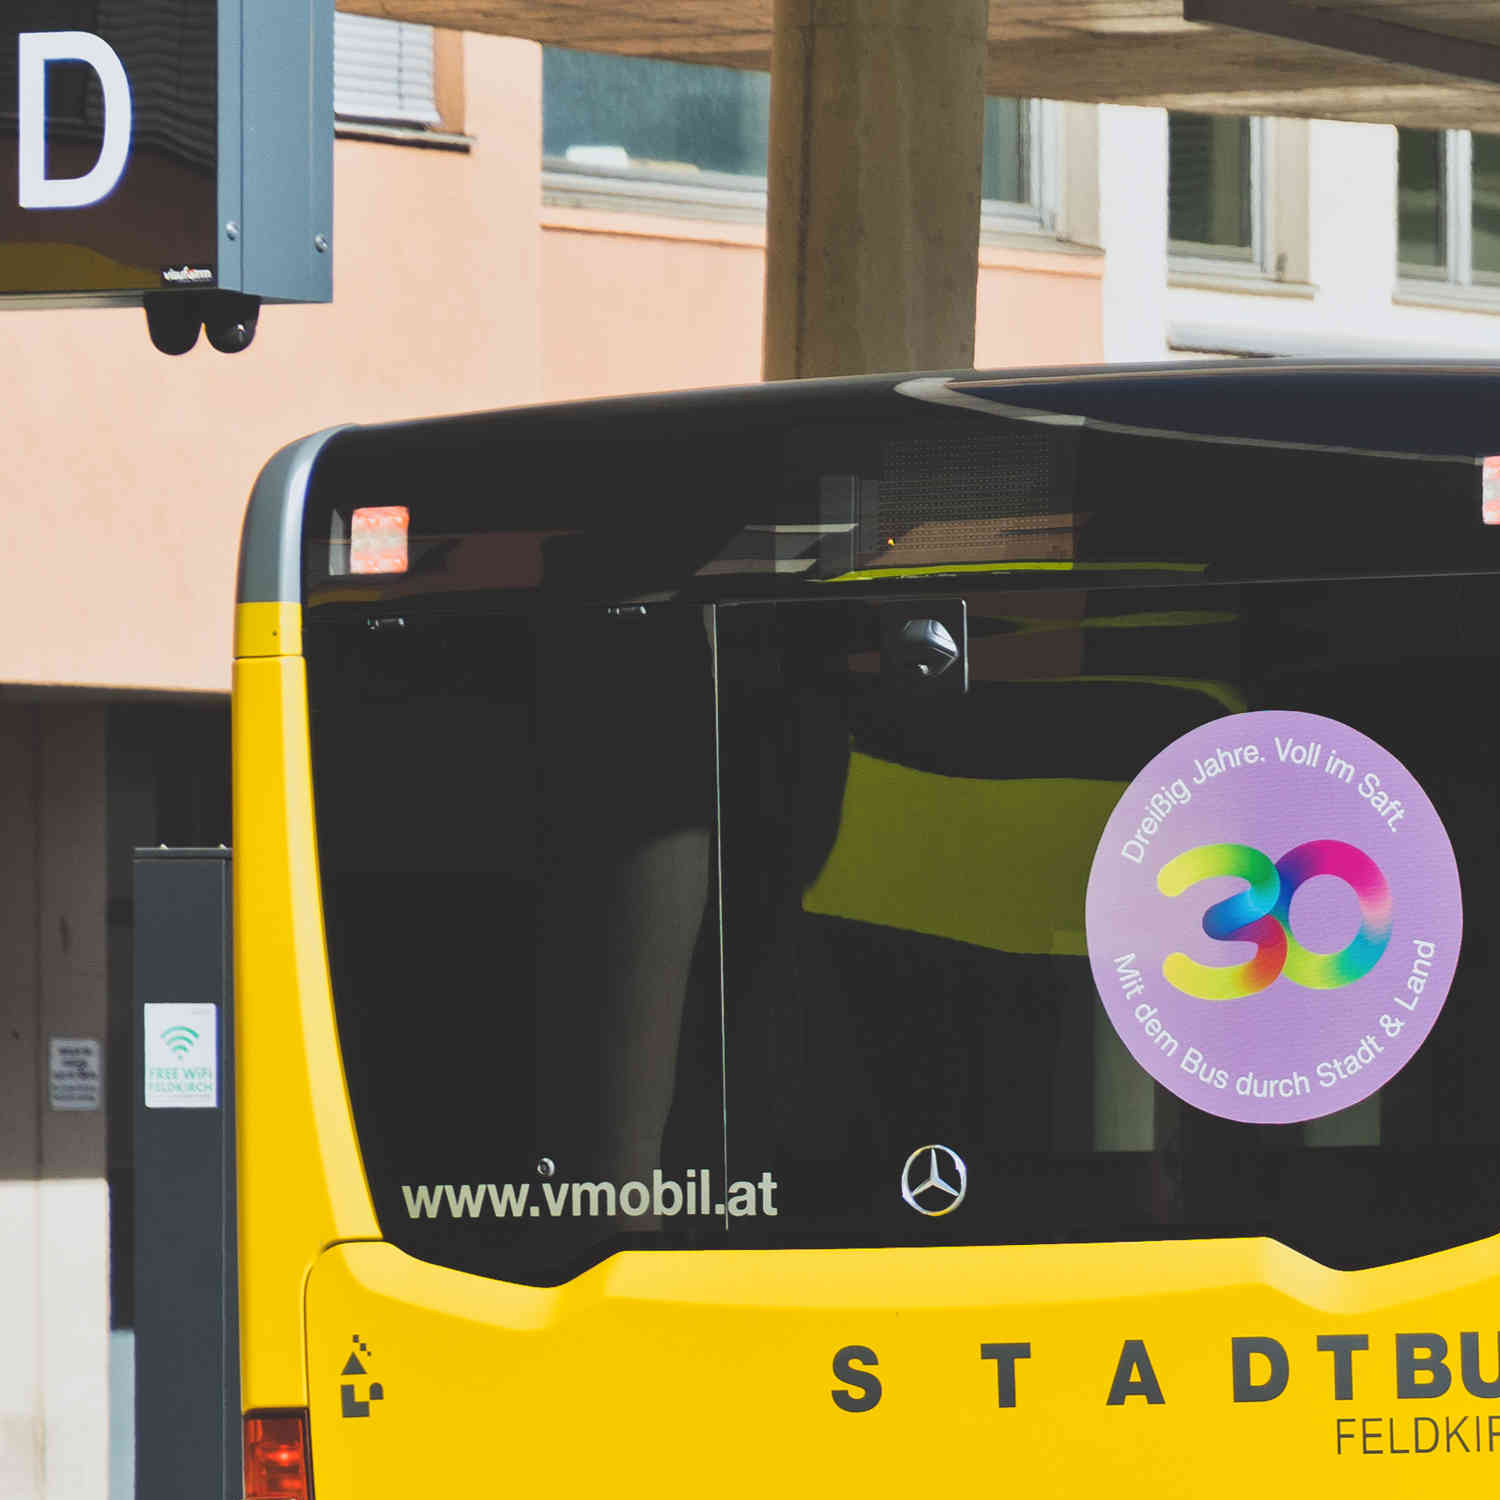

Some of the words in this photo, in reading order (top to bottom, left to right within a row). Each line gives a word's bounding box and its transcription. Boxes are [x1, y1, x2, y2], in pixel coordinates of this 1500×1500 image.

[18, 30, 132, 210] D
[1121, 778, 1191, 864] Dreißig
[1192, 742, 1265, 785] Jahre.
[1274, 737, 1321, 768] Voll
[1325, 750, 1356, 783] im
[1358, 773, 1406, 833] Saft.
[1156, 839, 1393, 1001] 30
[1113, 952, 1145, 1000] Mit
[1134, 1000, 1179, 1057] dem
[1180, 1047, 1229, 1089] Bus
[1236, 1071, 1311, 1098] durch
[1316, 1034, 1385, 1088] Stadt
[1379, 1013, 1406, 1038] &
[1394, 939, 1436, 1011] Land
[402, 1169, 777, 1219] www.vmobil.at
